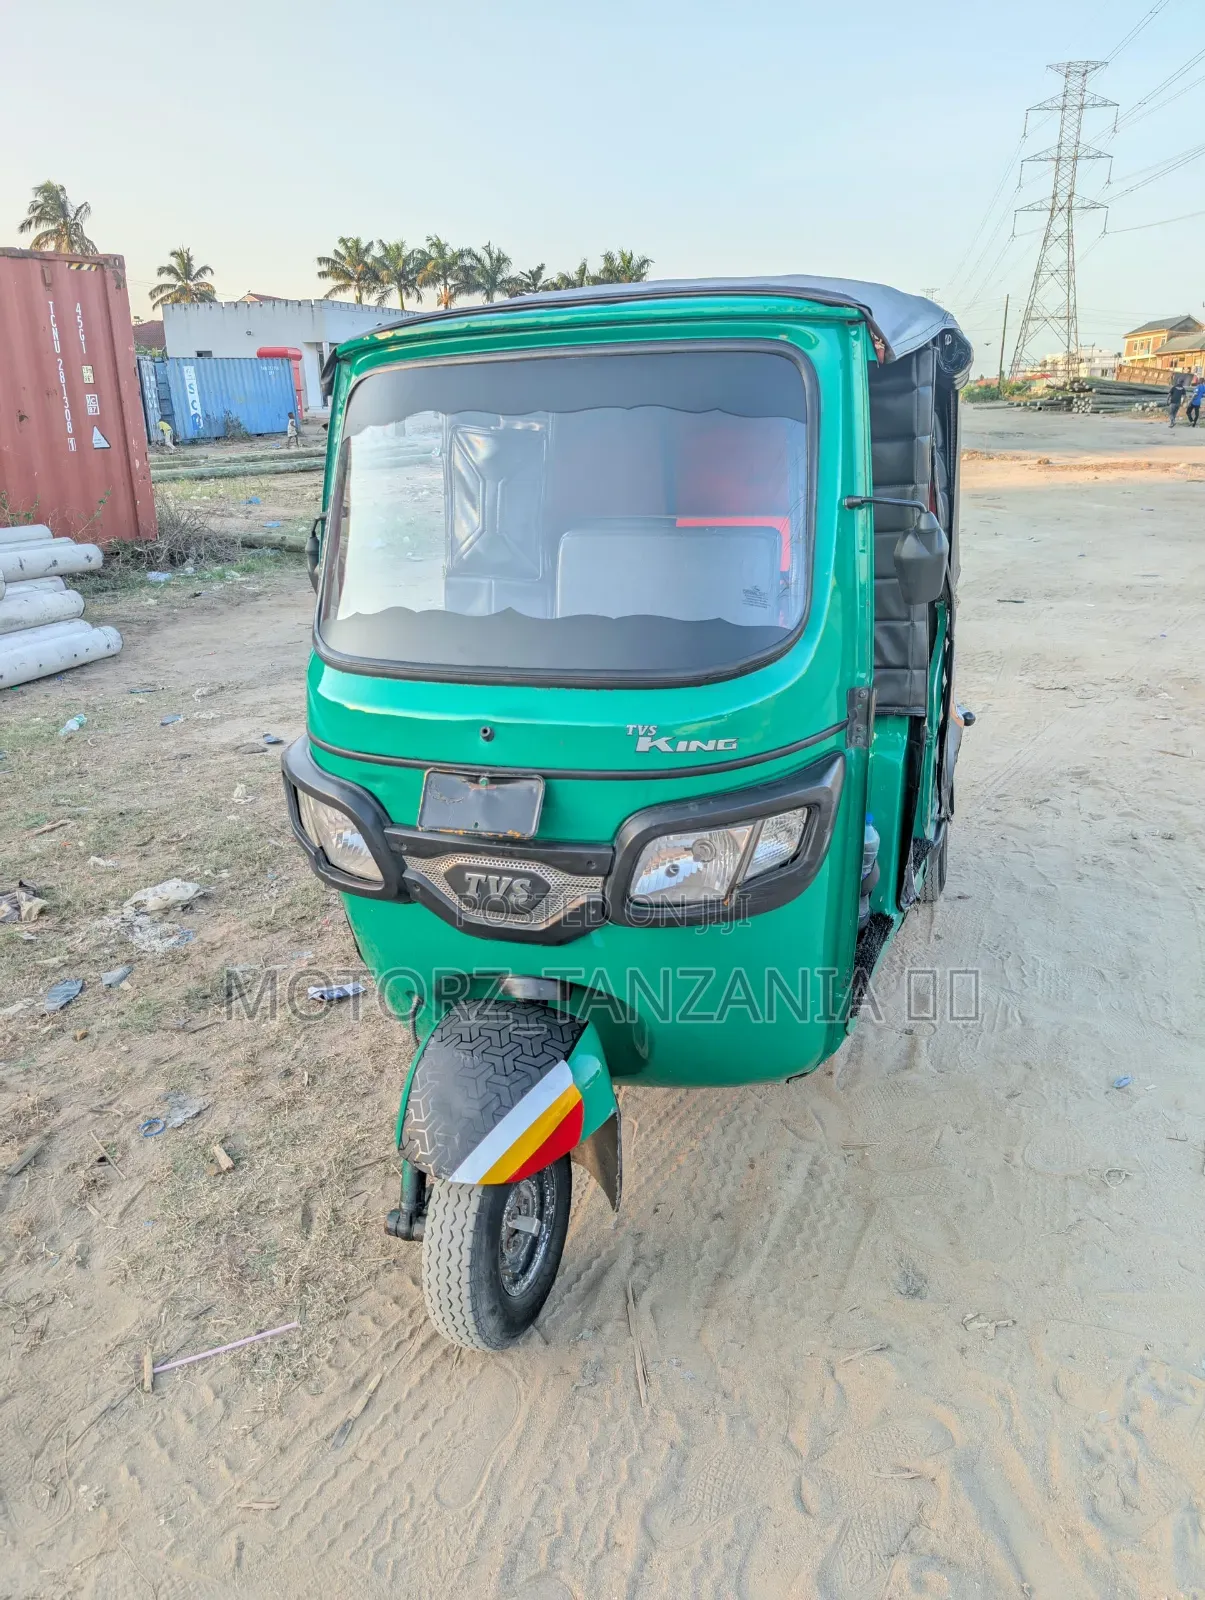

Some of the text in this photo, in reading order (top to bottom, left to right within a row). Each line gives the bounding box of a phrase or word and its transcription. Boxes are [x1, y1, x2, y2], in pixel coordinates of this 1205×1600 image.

[75, 302, 86, 354] 45G1
[48, 300, 61, 354] TCNU
[57, 358, 73, 434] 281308
[626, 724, 657, 736] TVS
[635, 736, 739, 753] KING
[464, 872, 532, 904] TVS
